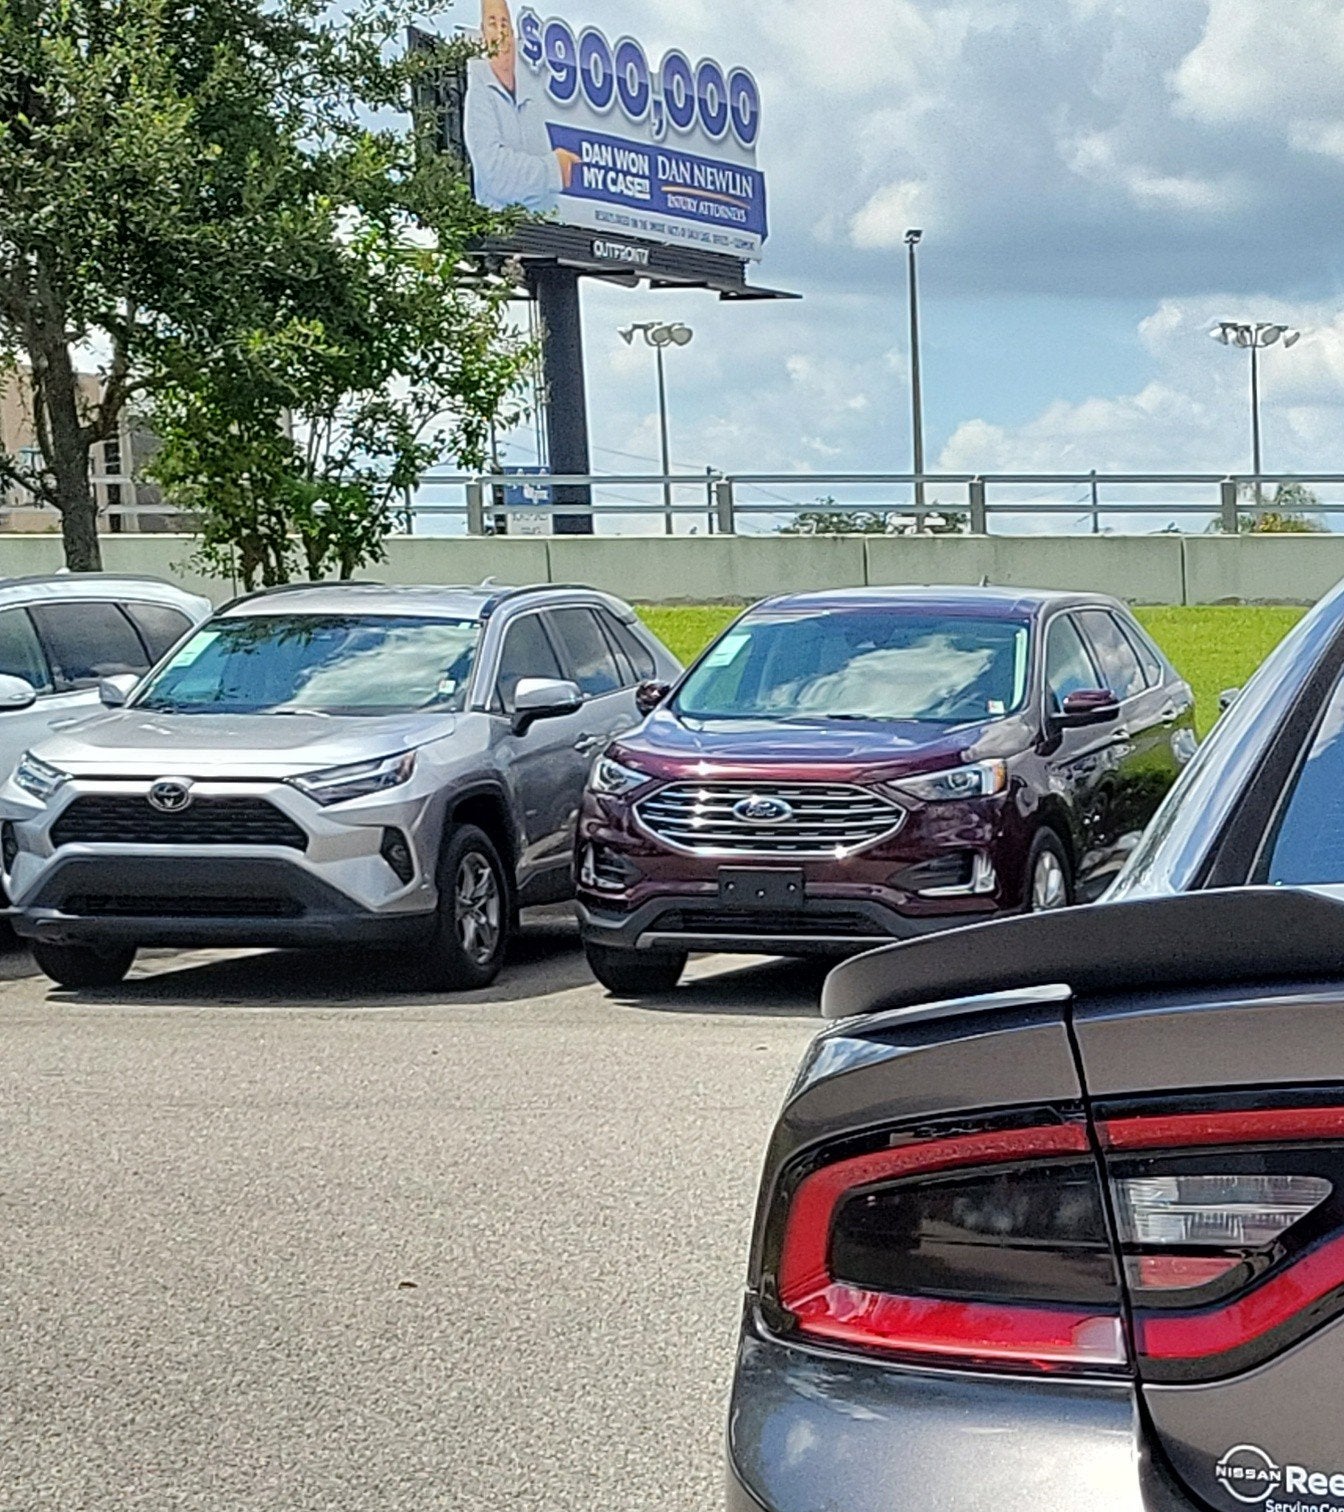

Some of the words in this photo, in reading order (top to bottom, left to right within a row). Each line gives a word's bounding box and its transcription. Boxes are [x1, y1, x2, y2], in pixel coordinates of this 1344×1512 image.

[517, 10, 760, 147] $900,000
[581, 142, 612, 166] DAN
[614, 148, 650, 176] WON
[583, 166, 605, 190] MY
[657, 155, 692, 184] DAN
[694, 163, 754, 198] NEWLIN
[1215, 1464, 1281, 1482] NISSAN
